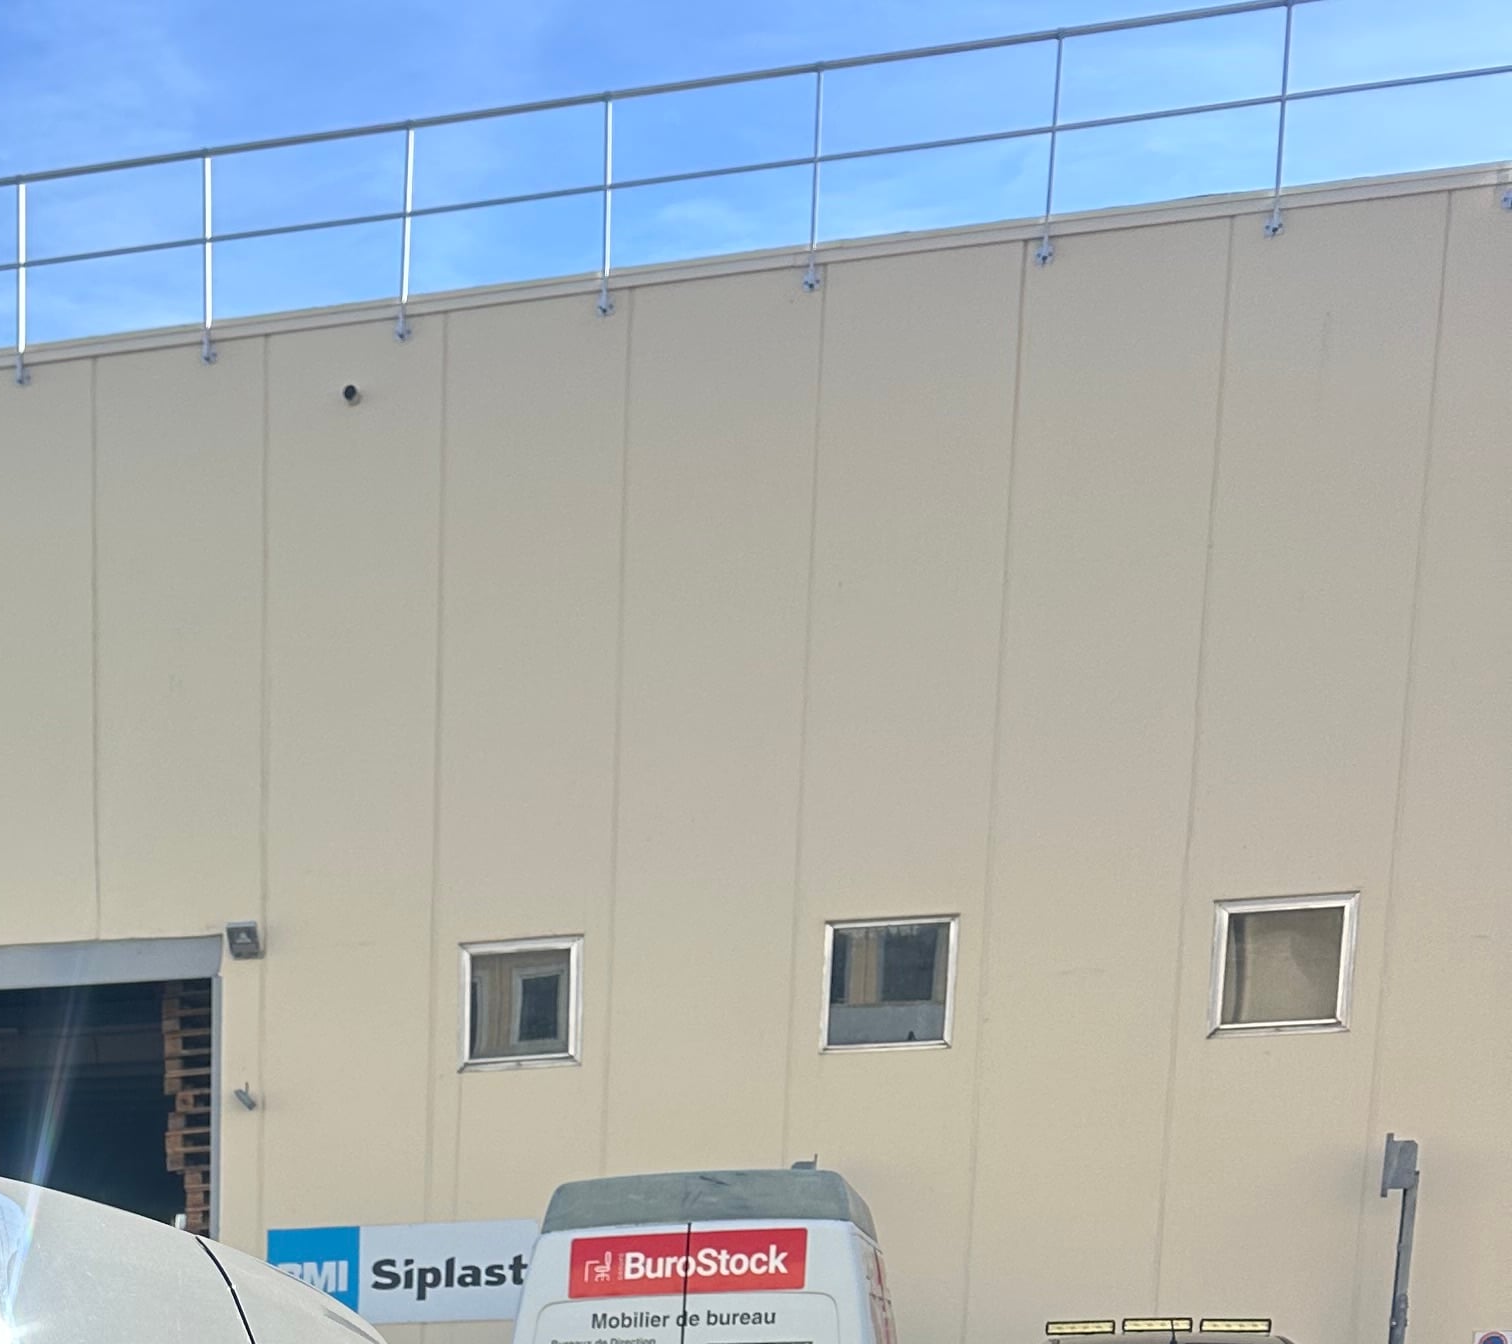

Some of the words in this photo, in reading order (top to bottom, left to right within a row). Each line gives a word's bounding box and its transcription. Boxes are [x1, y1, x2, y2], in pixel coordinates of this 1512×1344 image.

[371, 1254, 528, 1301] Siplast
[624, 1244, 788, 1280] BuroStock
[591, 1312, 670, 1330] Mobilier
[676, 1310, 700, 1328] de
[706, 1310, 776, 1327] bureau
